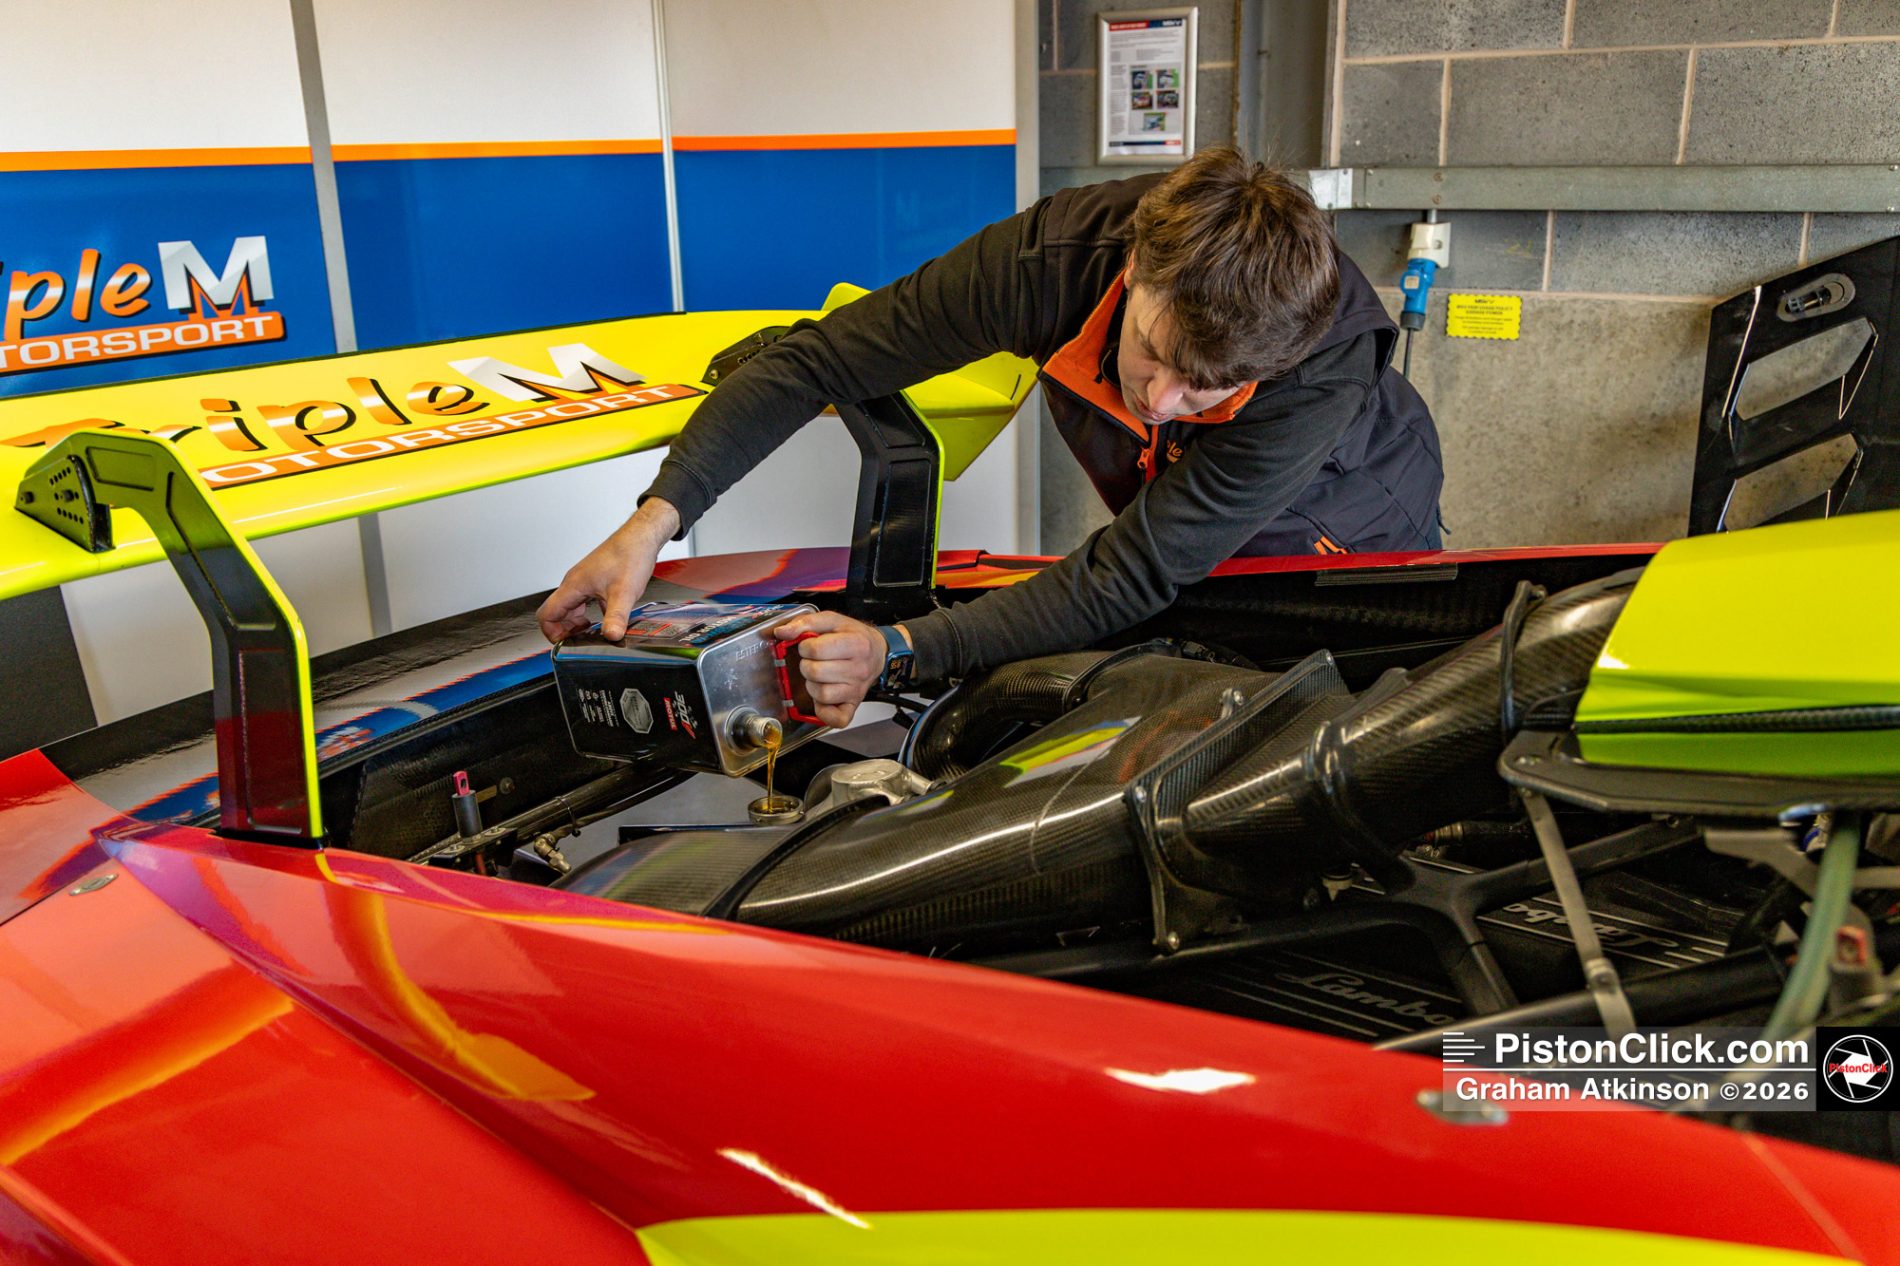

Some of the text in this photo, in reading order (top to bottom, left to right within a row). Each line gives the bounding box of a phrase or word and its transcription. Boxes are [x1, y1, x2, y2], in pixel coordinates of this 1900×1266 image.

[0, 248, 151, 341] ple
[0, 316, 273, 369] TORSPORT
[200, 386, 669, 482] OTORSPORT
